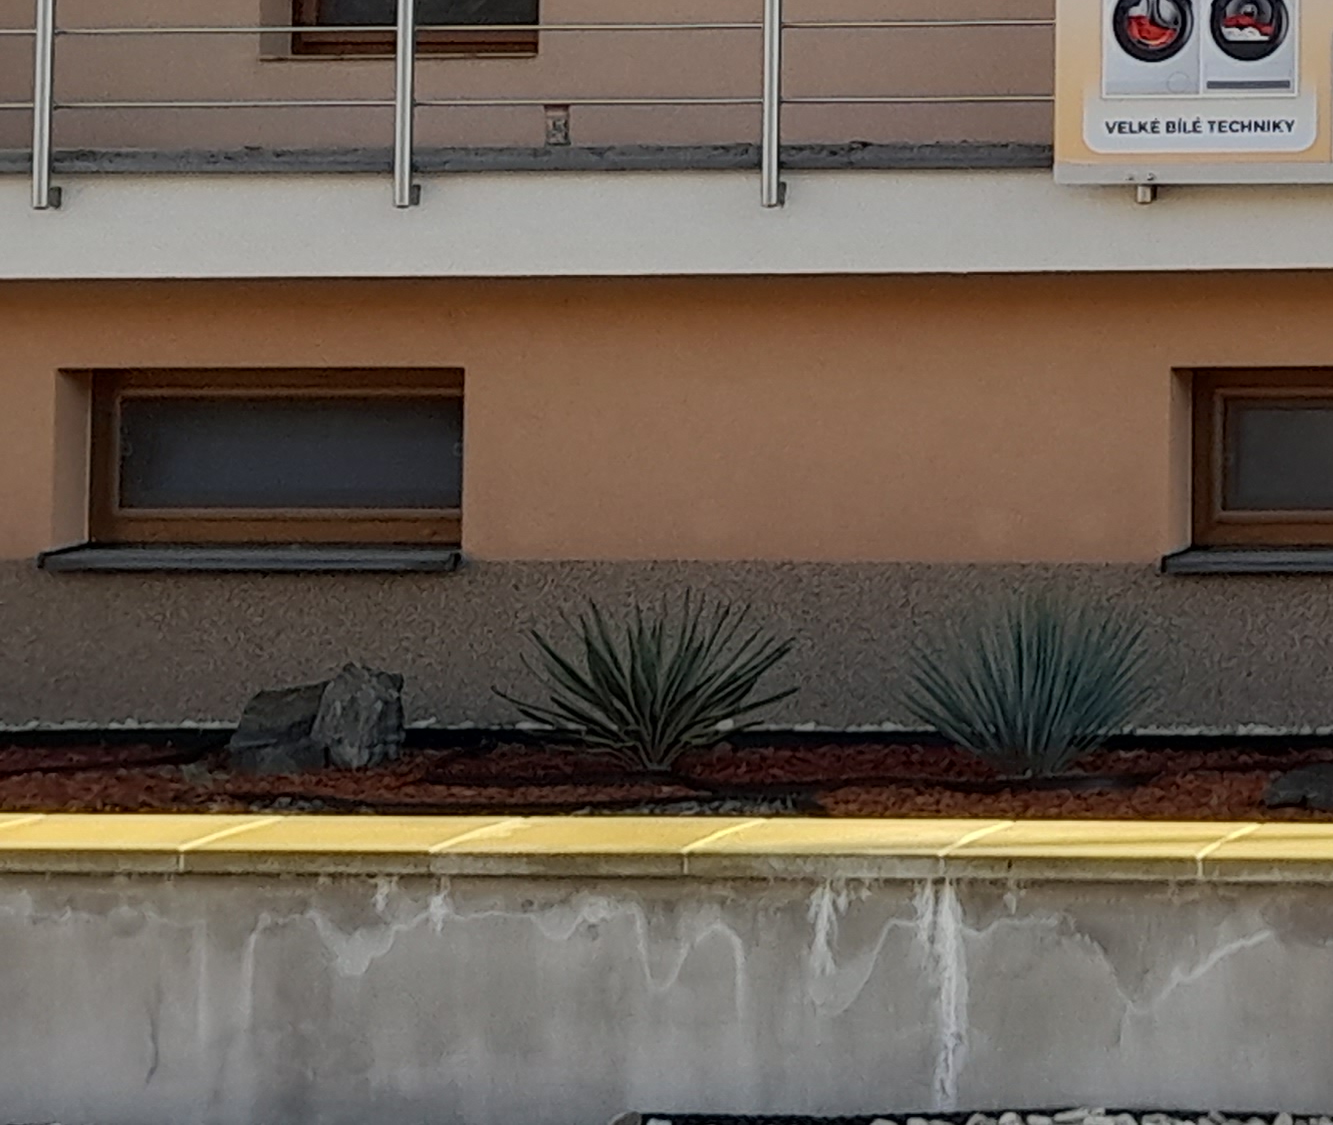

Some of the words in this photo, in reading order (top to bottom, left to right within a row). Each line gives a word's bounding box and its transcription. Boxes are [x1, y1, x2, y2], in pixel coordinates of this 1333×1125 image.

[1105, 118, 1161, 134] VELKÉ
[1165, 117, 1203, 134] BÍLÉ
[1206, 118, 1296, 133] TECHNIKY
